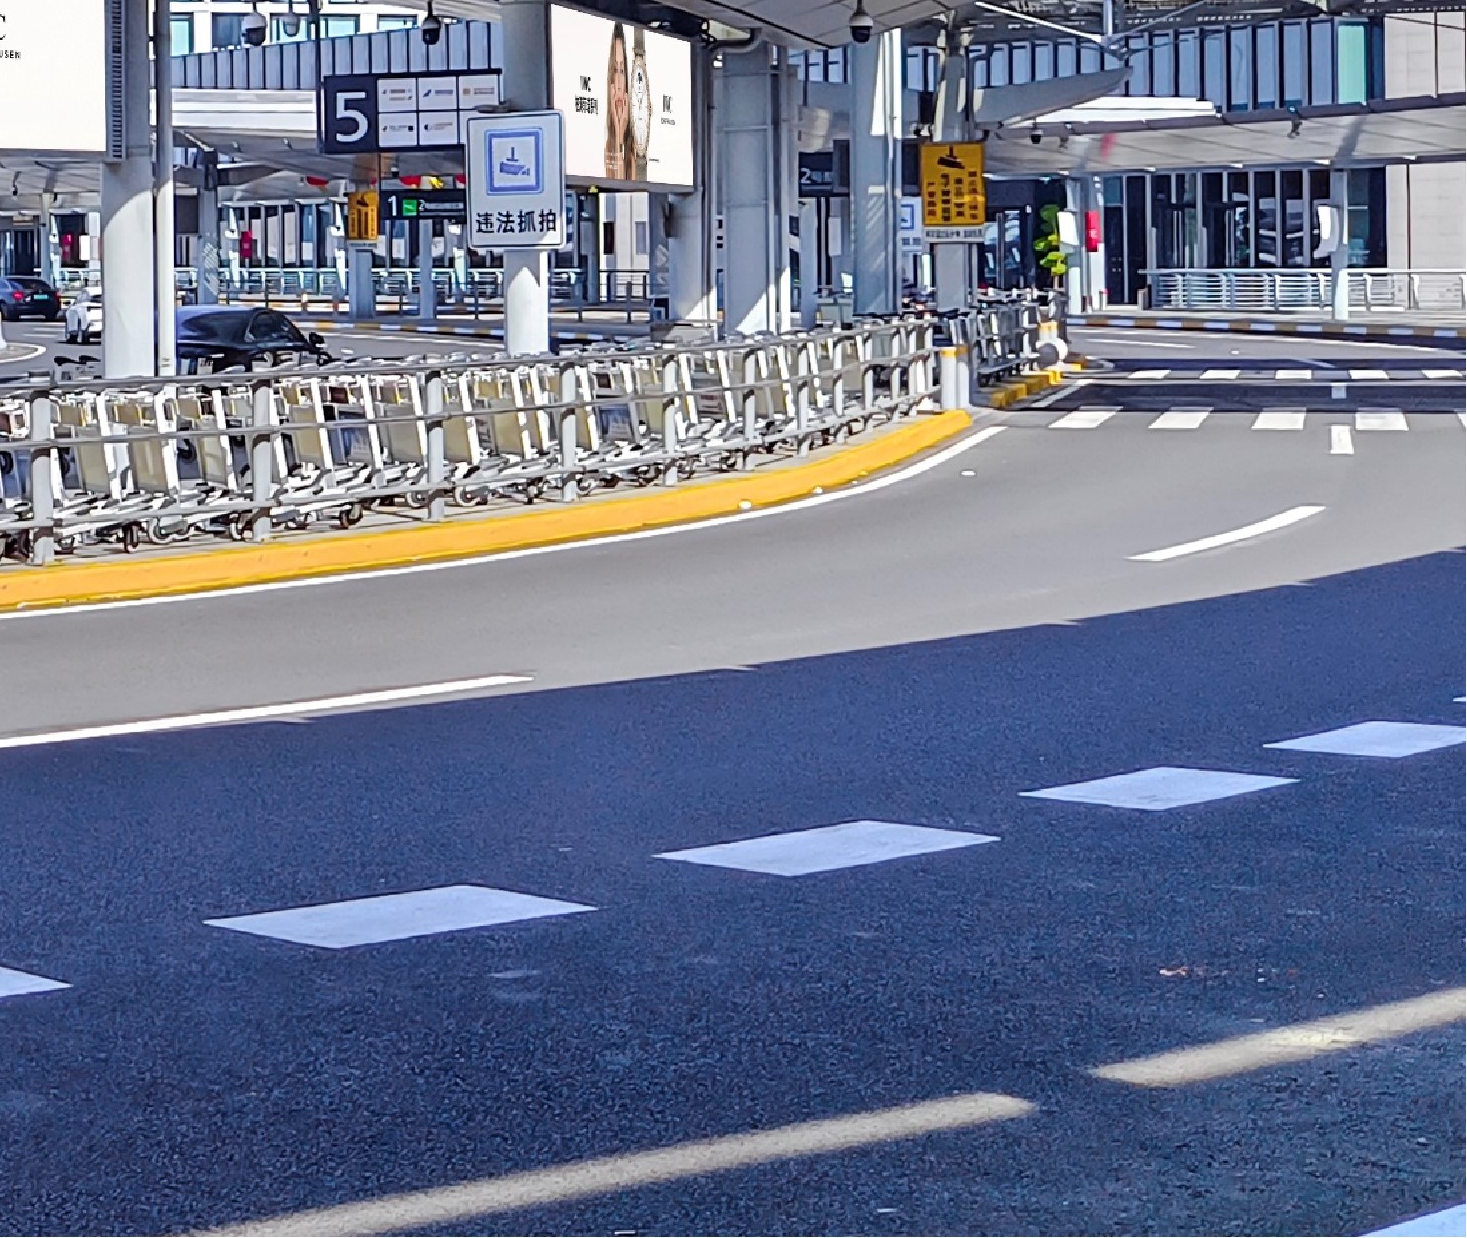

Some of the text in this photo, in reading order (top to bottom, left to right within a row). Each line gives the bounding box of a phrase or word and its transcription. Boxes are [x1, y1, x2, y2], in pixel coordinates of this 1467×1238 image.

[336, 91, 368, 142] 5
[388, 195, 397, 216] 1
[475, 208, 557, 234] 违法抓拍
